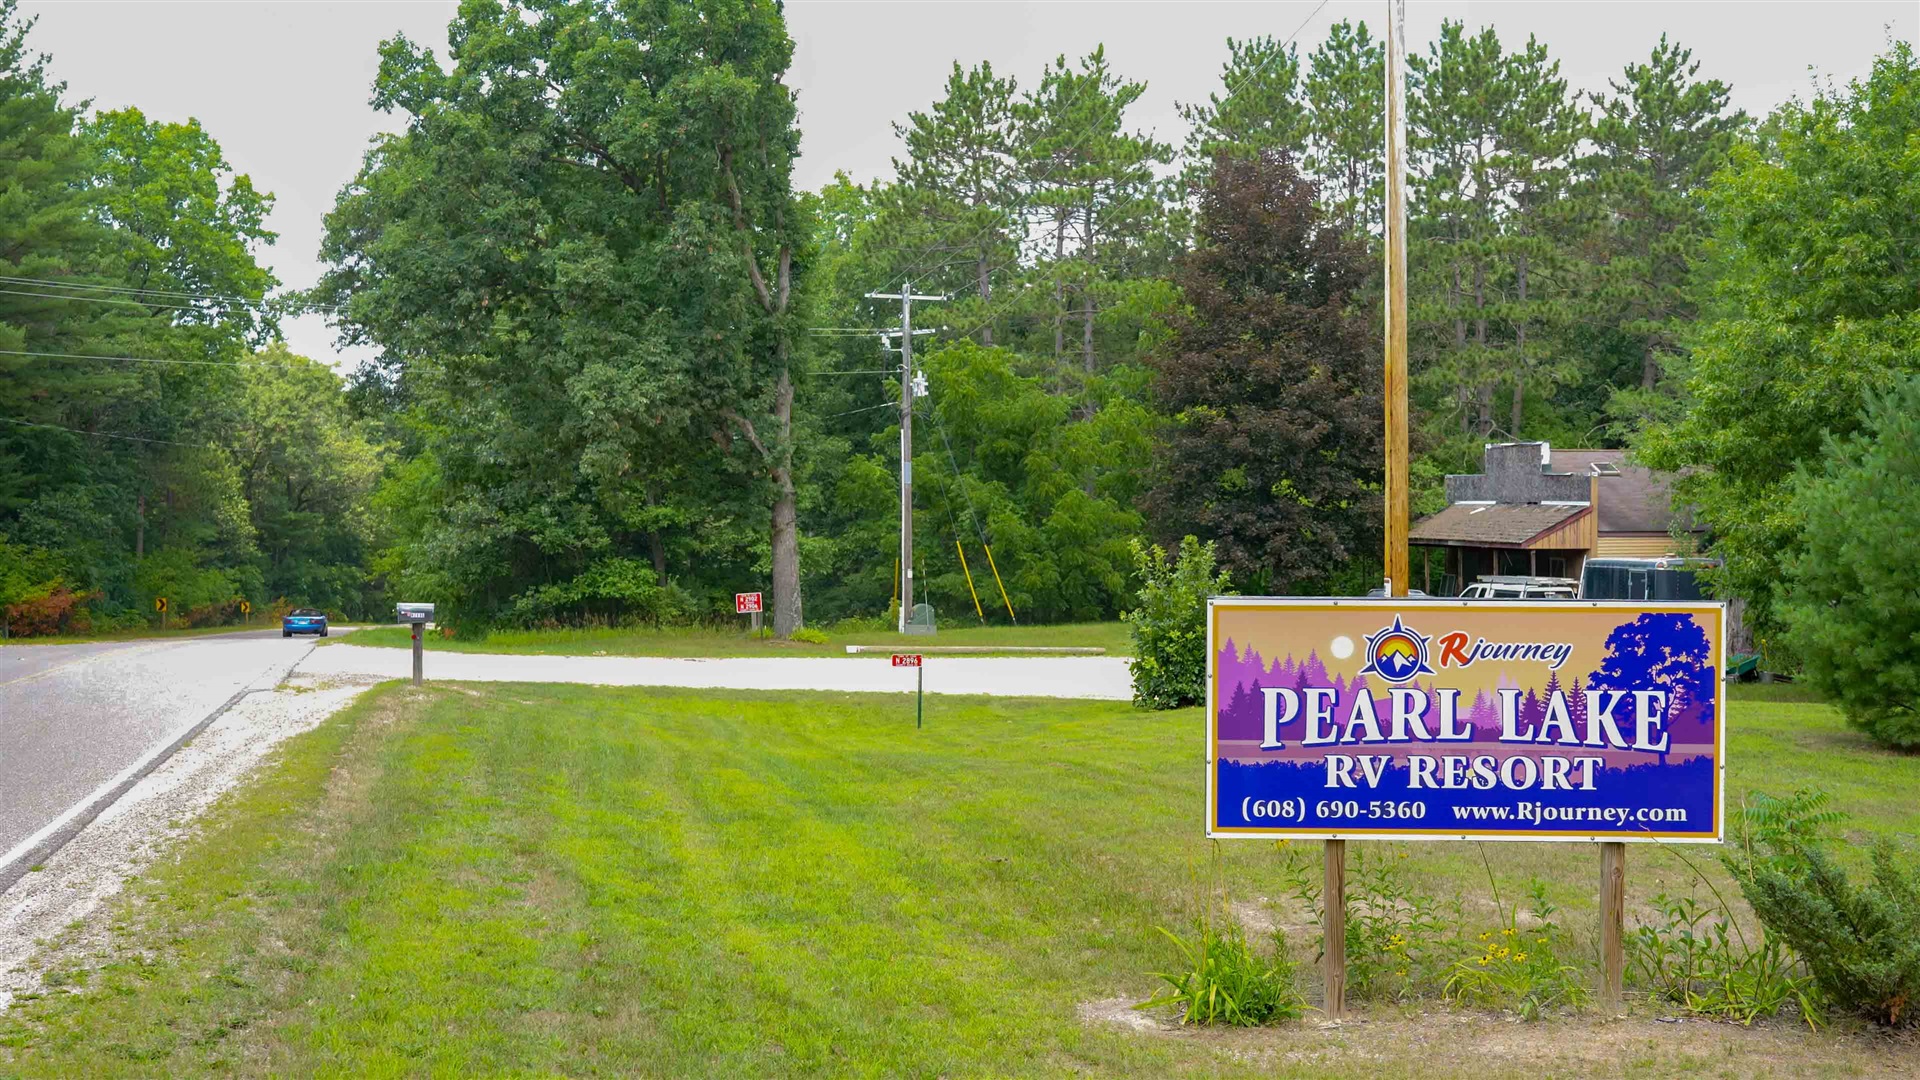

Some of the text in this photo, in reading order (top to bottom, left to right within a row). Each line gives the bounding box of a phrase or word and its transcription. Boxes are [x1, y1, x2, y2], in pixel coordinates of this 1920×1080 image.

[1439, 632, 1572, 669] Rjourney
[1260, 688, 1669, 752] PEARL LAKE
[1324, 755, 1603, 791] RV RESORT
[1242, 796, 1688, 826] (608) 690-5360 www.Rjourney.com
